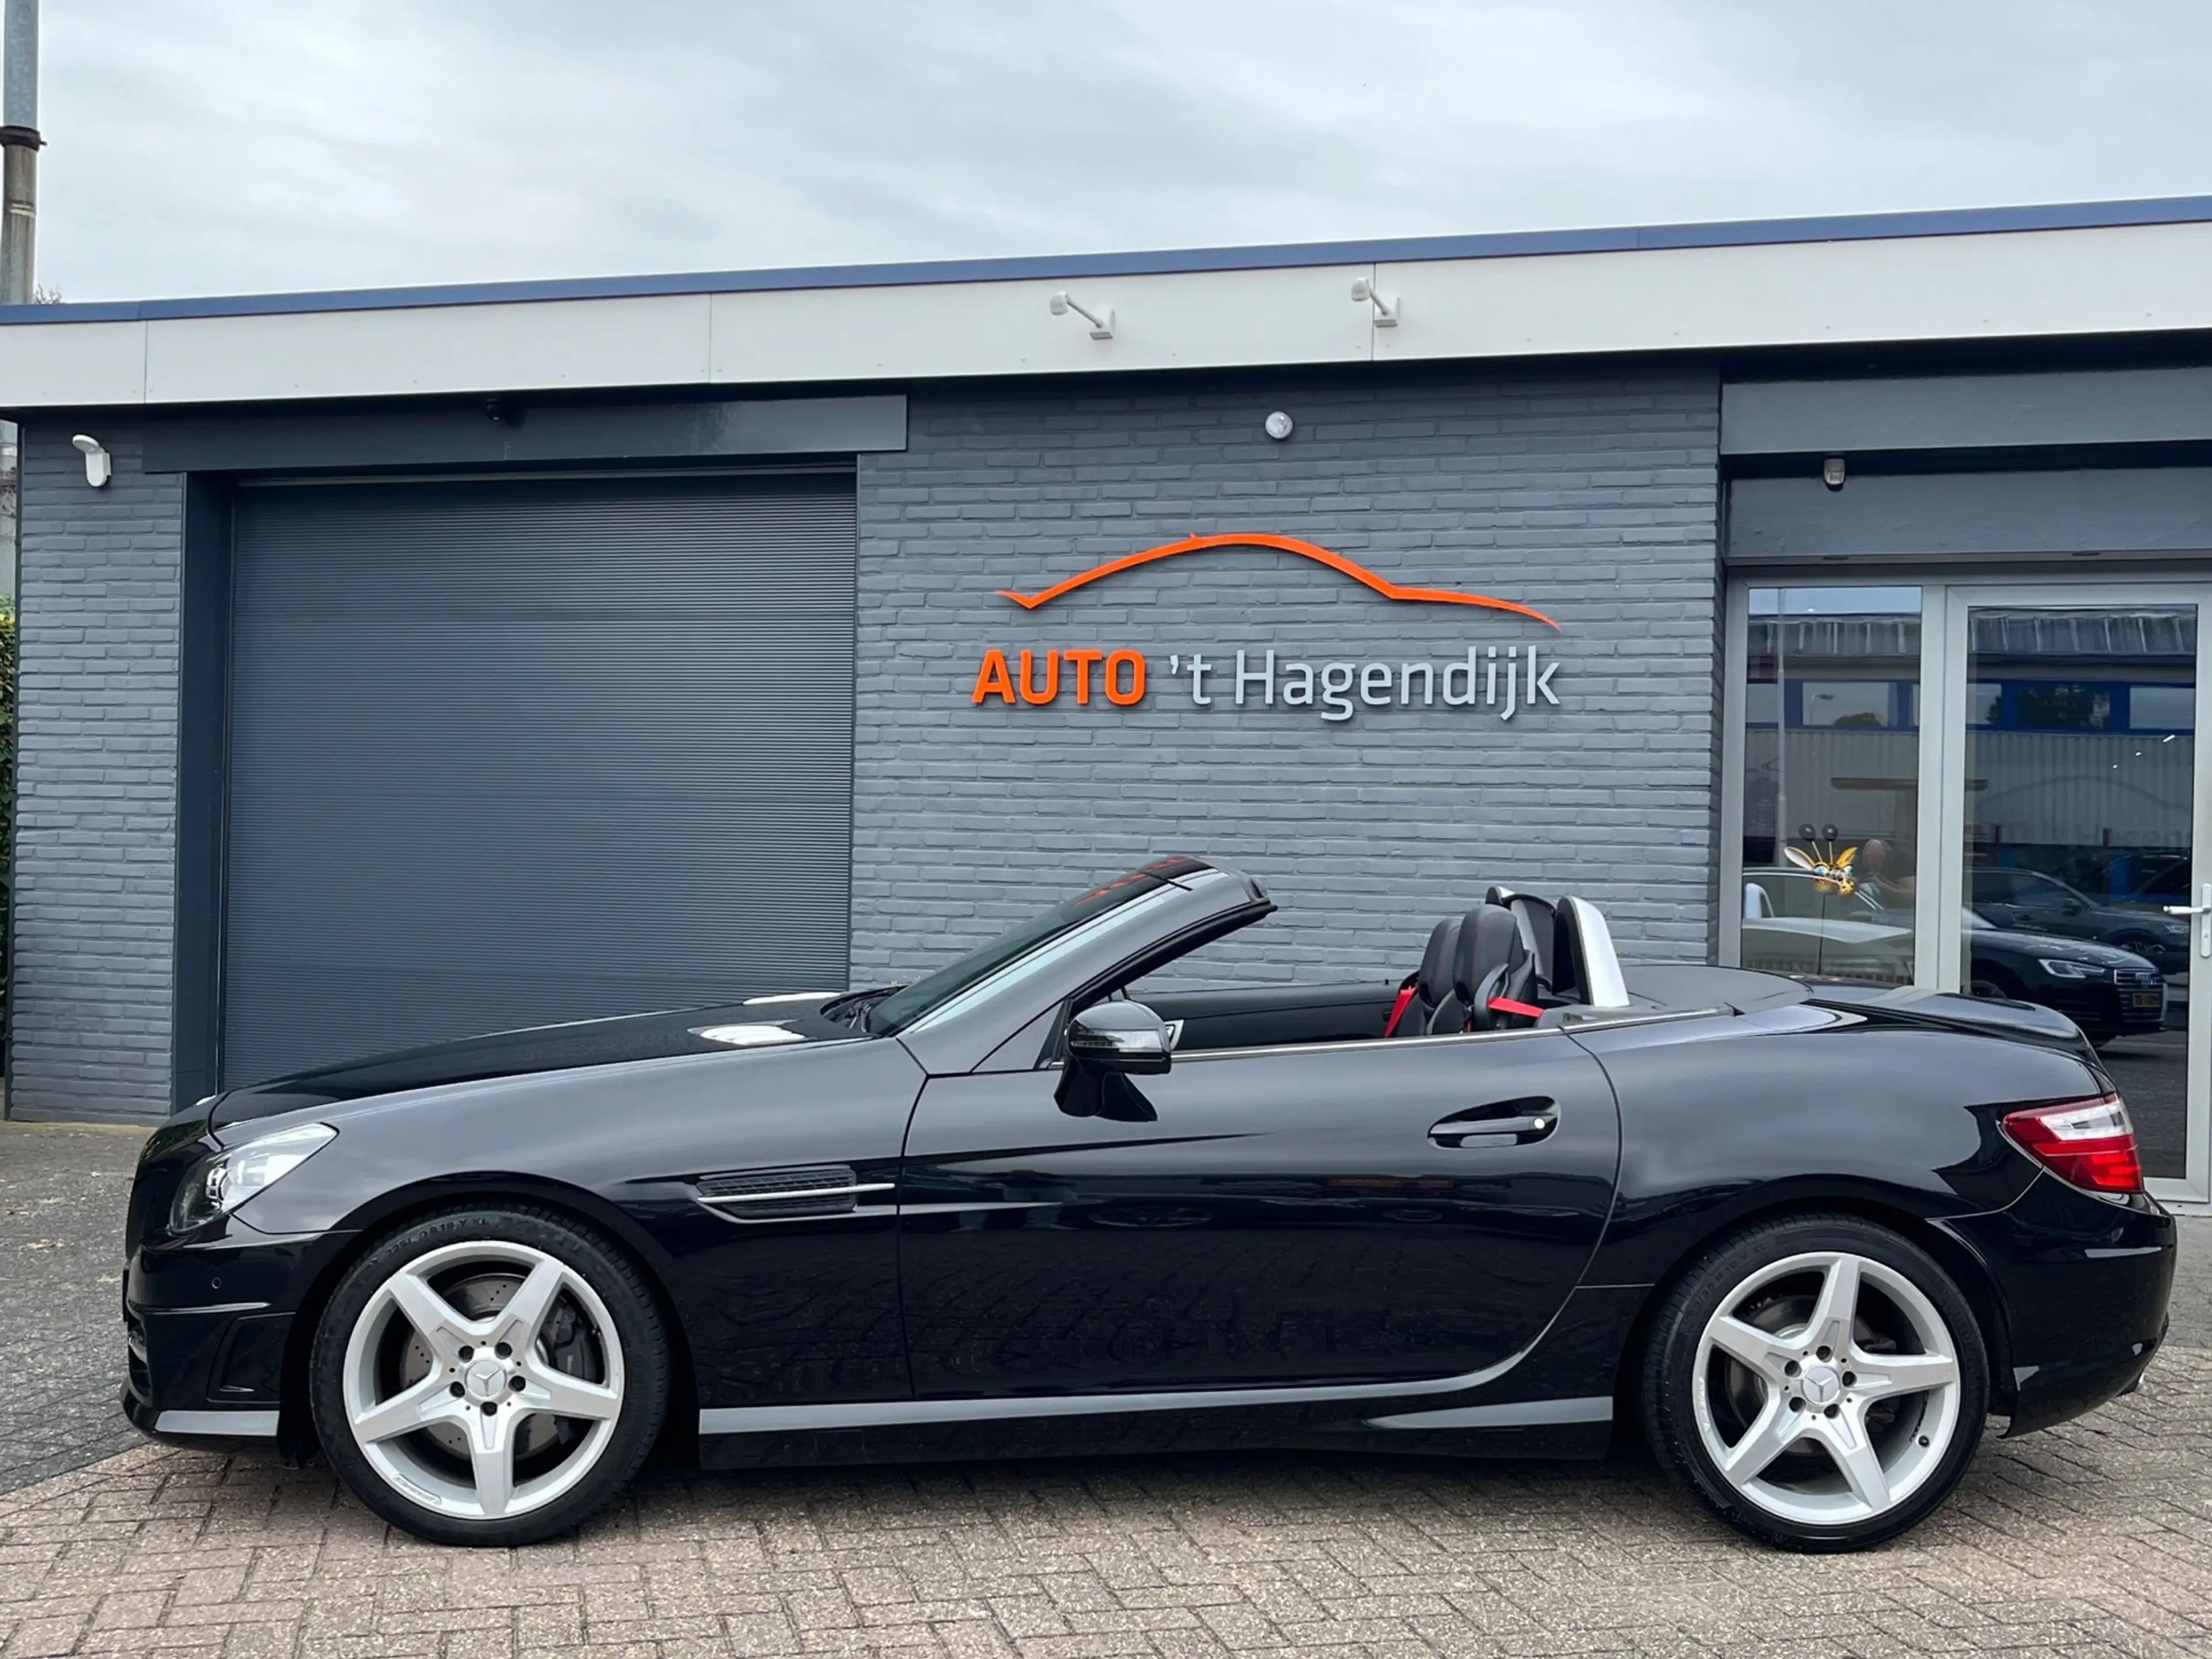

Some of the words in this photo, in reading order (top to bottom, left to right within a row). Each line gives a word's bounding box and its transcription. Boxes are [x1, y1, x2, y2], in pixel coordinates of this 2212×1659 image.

[972, 649, 1145, 705] AUTO
[1170, 653, 1211, 704] 't
[1236, 645, 1560, 720] Hagendijk
